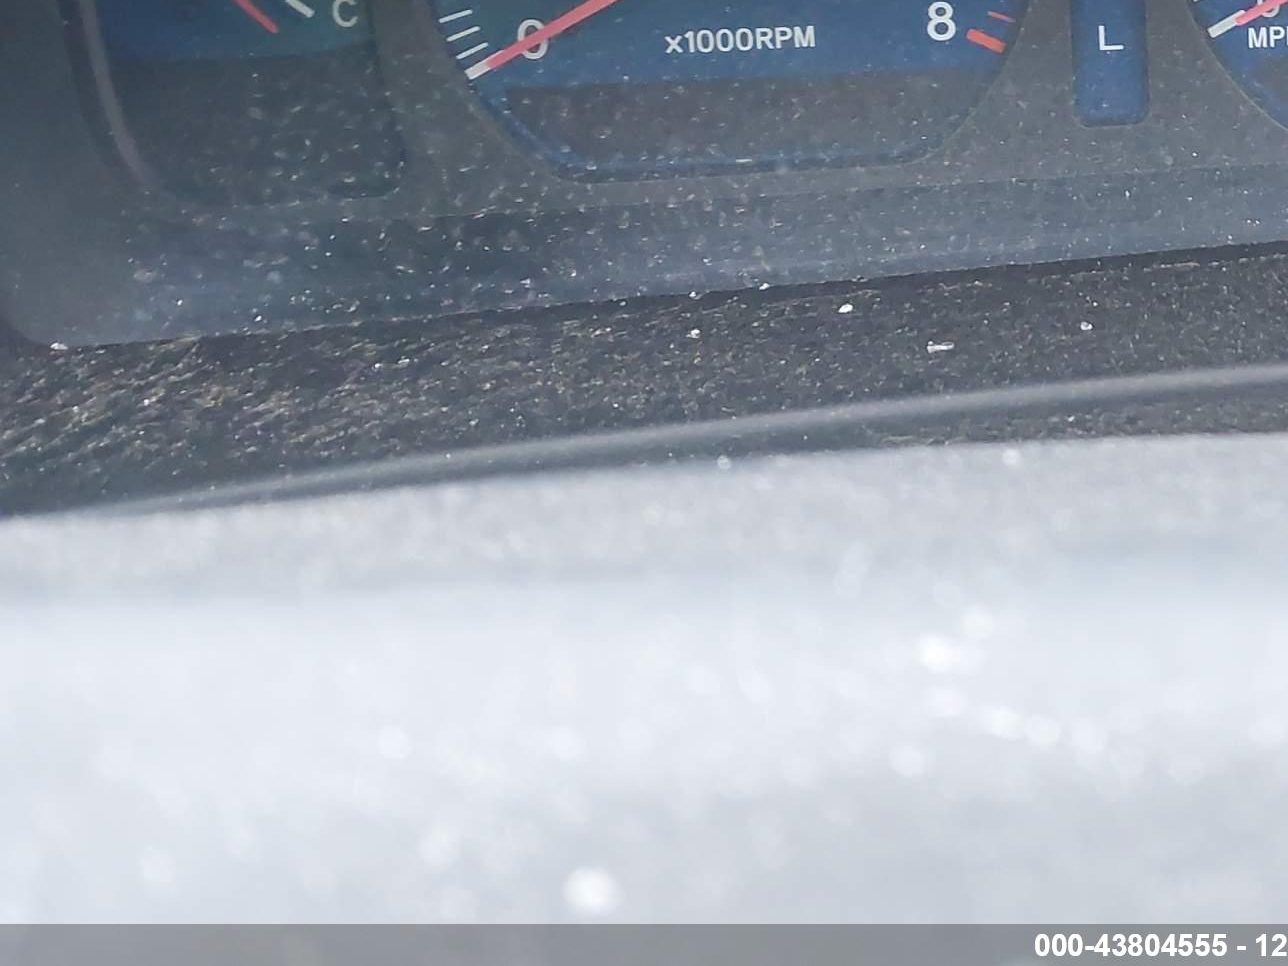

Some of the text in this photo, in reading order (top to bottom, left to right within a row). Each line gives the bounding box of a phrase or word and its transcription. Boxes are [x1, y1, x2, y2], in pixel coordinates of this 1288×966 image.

[927, 1, 956, 41] 8
[1099, 25, 1124, 51] L
[517, 19, 548, 60] 0
[665, 25, 816, 55] x1000RPM
